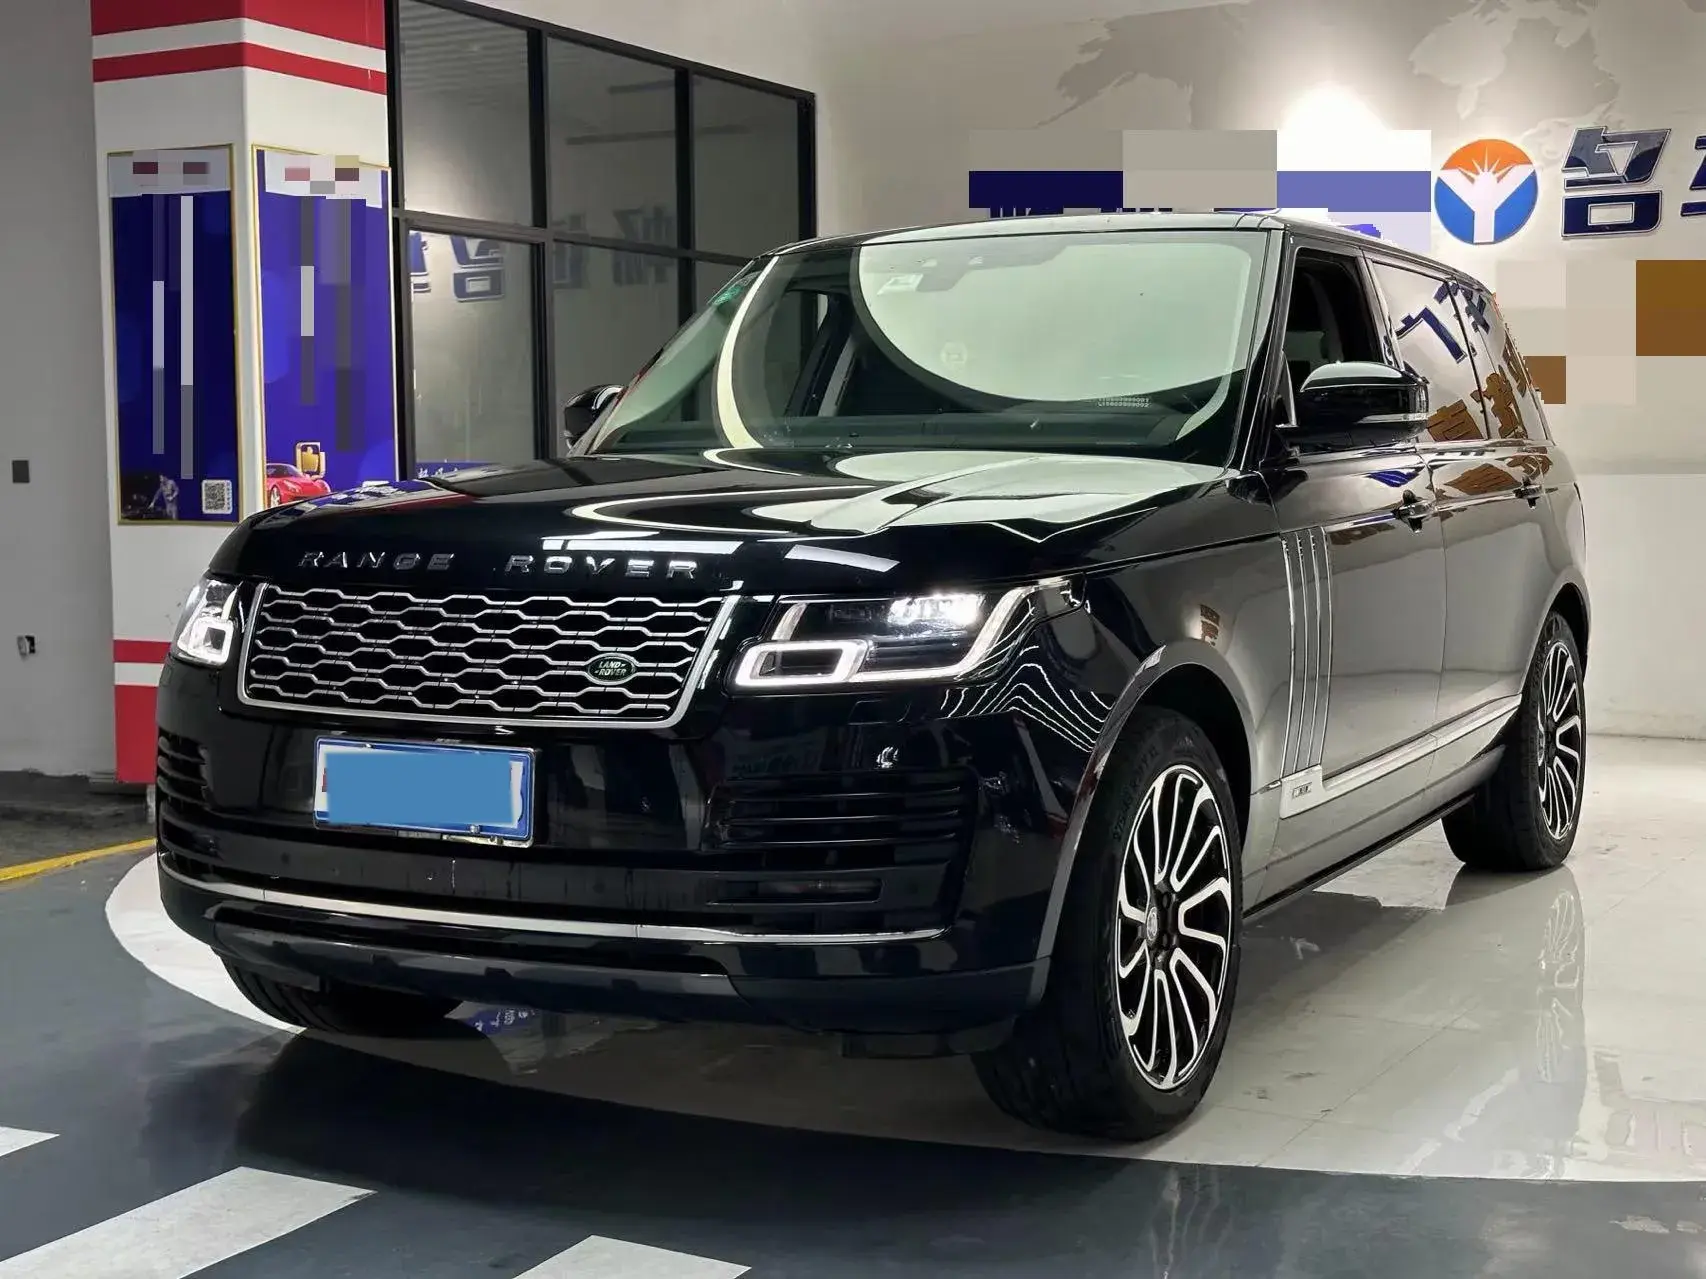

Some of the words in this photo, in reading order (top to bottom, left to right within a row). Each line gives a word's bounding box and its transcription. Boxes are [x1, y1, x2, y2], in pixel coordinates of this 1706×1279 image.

[298, 551, 455, 570] RANGE
[504, 555, 698, 579] ROVER
[599, 661, 622, 669] LAND
[598, 668, 627, 676] ROVER
